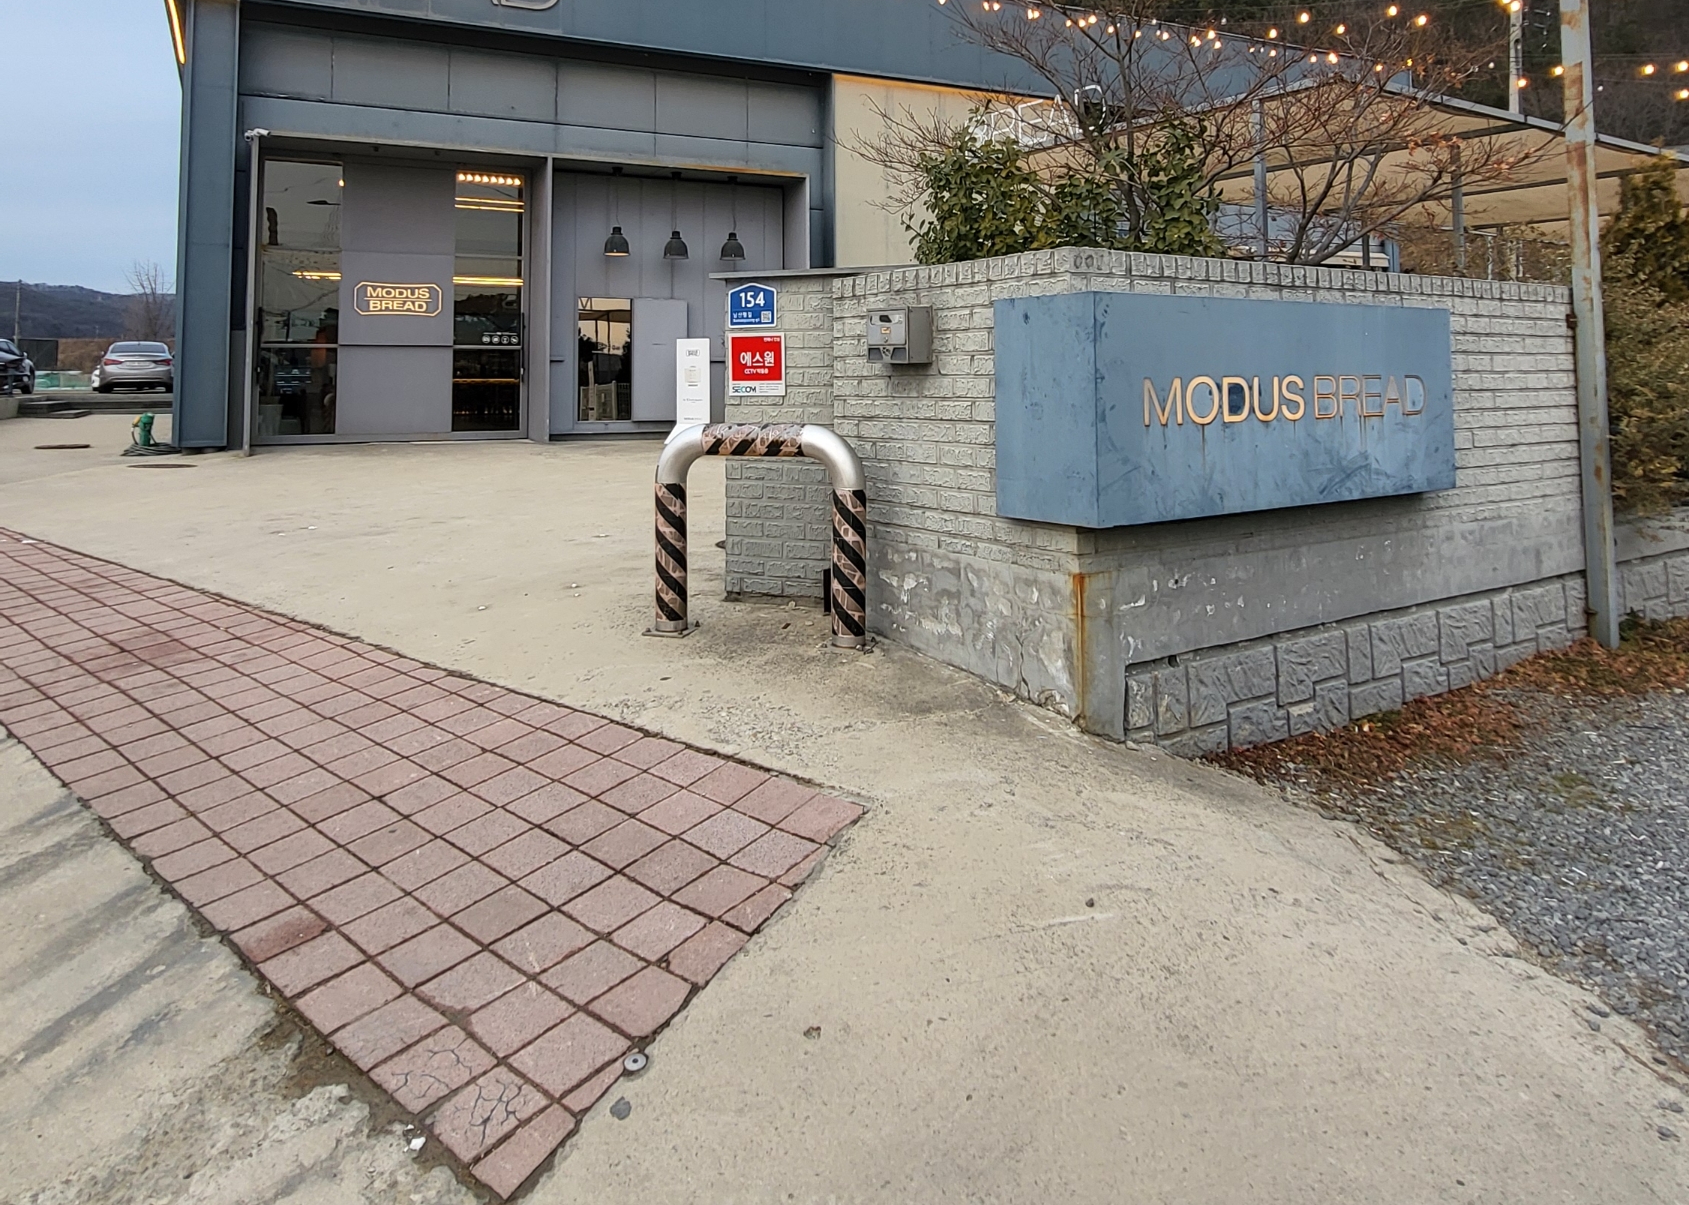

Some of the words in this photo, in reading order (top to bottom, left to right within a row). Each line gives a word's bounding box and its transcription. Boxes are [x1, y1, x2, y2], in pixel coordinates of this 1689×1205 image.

[366, 286, 430, 299] MODUS
[739, 291, 765, 308] 154
[368, 300, 427, 312] BREAD
[740, 351, 775, 367] 에스원
[732, 386, 757, 394] SECOM
[1142, 375, 1306, 427] MODUS
[1313, 374, 1427, 420] BREAD
